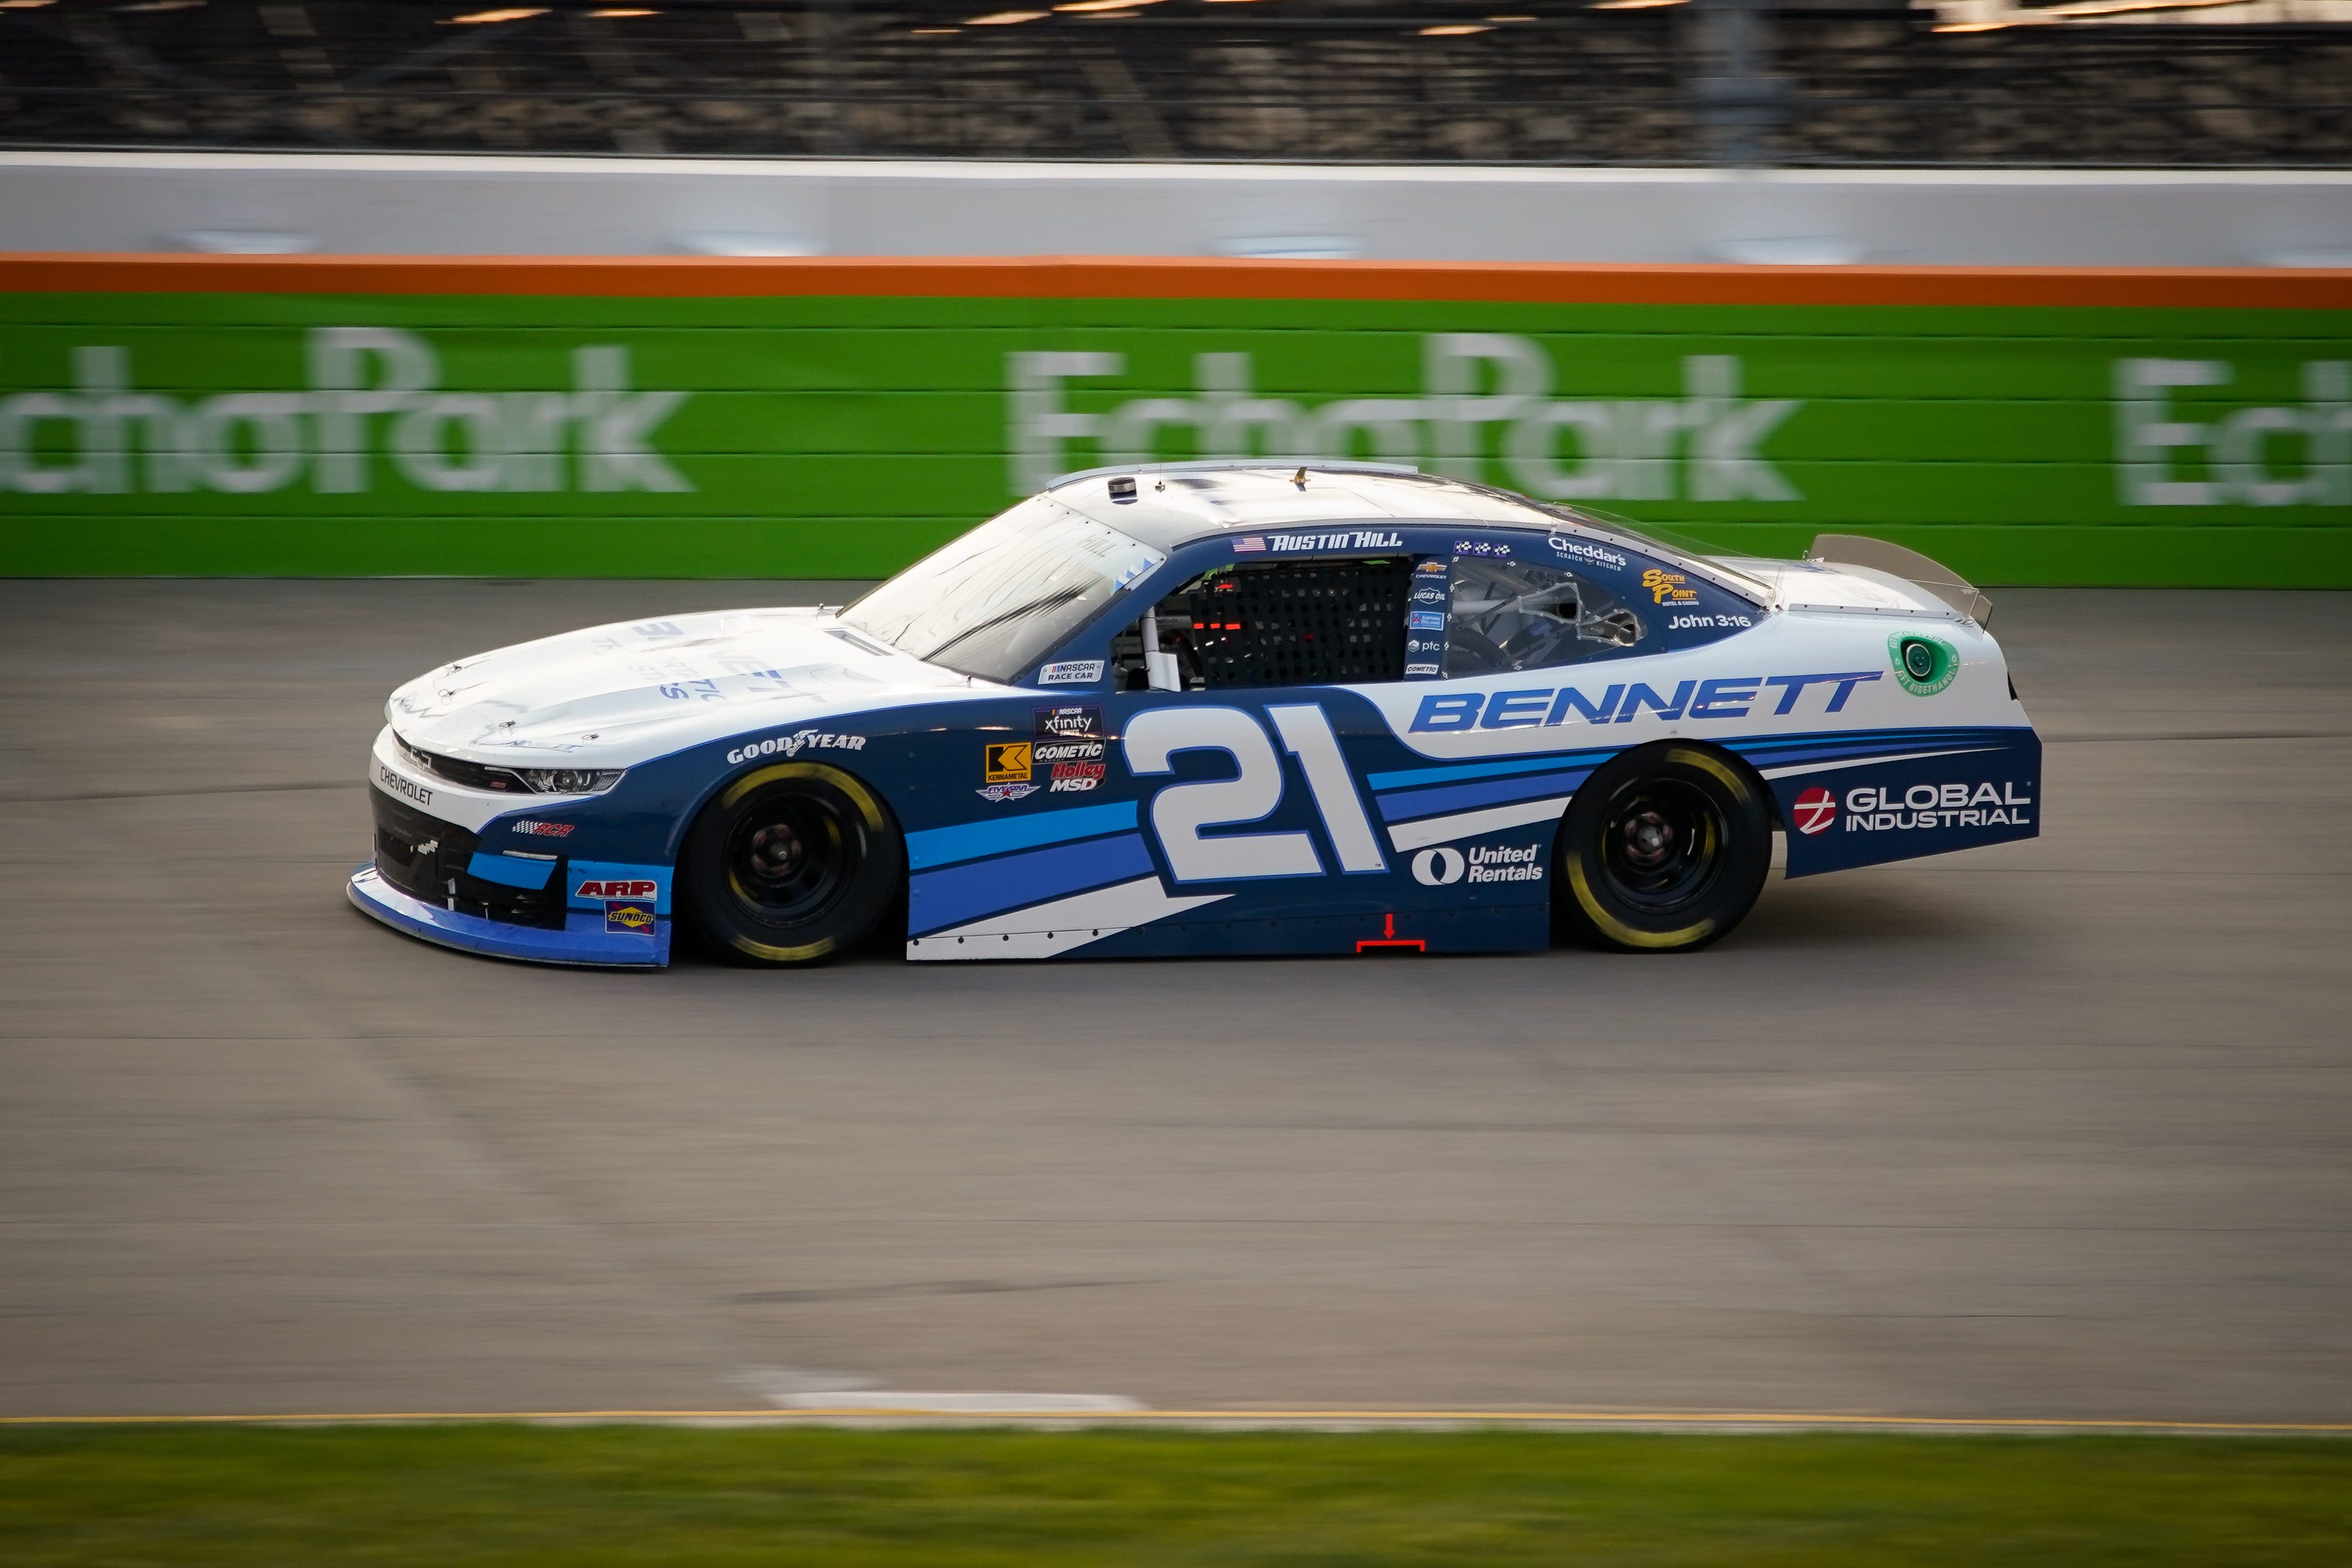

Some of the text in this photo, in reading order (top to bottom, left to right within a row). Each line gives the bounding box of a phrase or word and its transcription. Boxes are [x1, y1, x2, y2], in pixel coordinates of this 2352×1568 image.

[0, 327, 700, 494] choPark
[1267, 531, 1403, 551] AUSTIN HILL
[1548, 537, 1627, 566] Cheddar's
[1556, 551, 1582, 562] SCRATCH
[1668, 615, 1752, 629] John 3:16
[1422, 641, 1440, 652] ptc
[1060, 663, 1095, 672] NASCAR
[1408, 671, 1885, 734] BENNETT
[1045, 717, 1092, 734] xfinity
[1035, 743, 1103, 760] COMETIC
[1051, 762, 1105, 781] Holley
[380, 766, 433, 806] CHEVROLET
[1049, 778, 1098, 792] MSD
[1121, 702, 1390, 885] 21
[1846, 782, 2031, 813] GLOBAL
[1846, 808, 2030, 832] INDUSTRIAL
[532, 823, 575, 838] RCR
[1469, 844, 1537, 864] United
[1468, 864, 1543, 883] Rentals
[576, 881, 656, 896] ARP
[609, 912, 653, 923] SUNOCO
